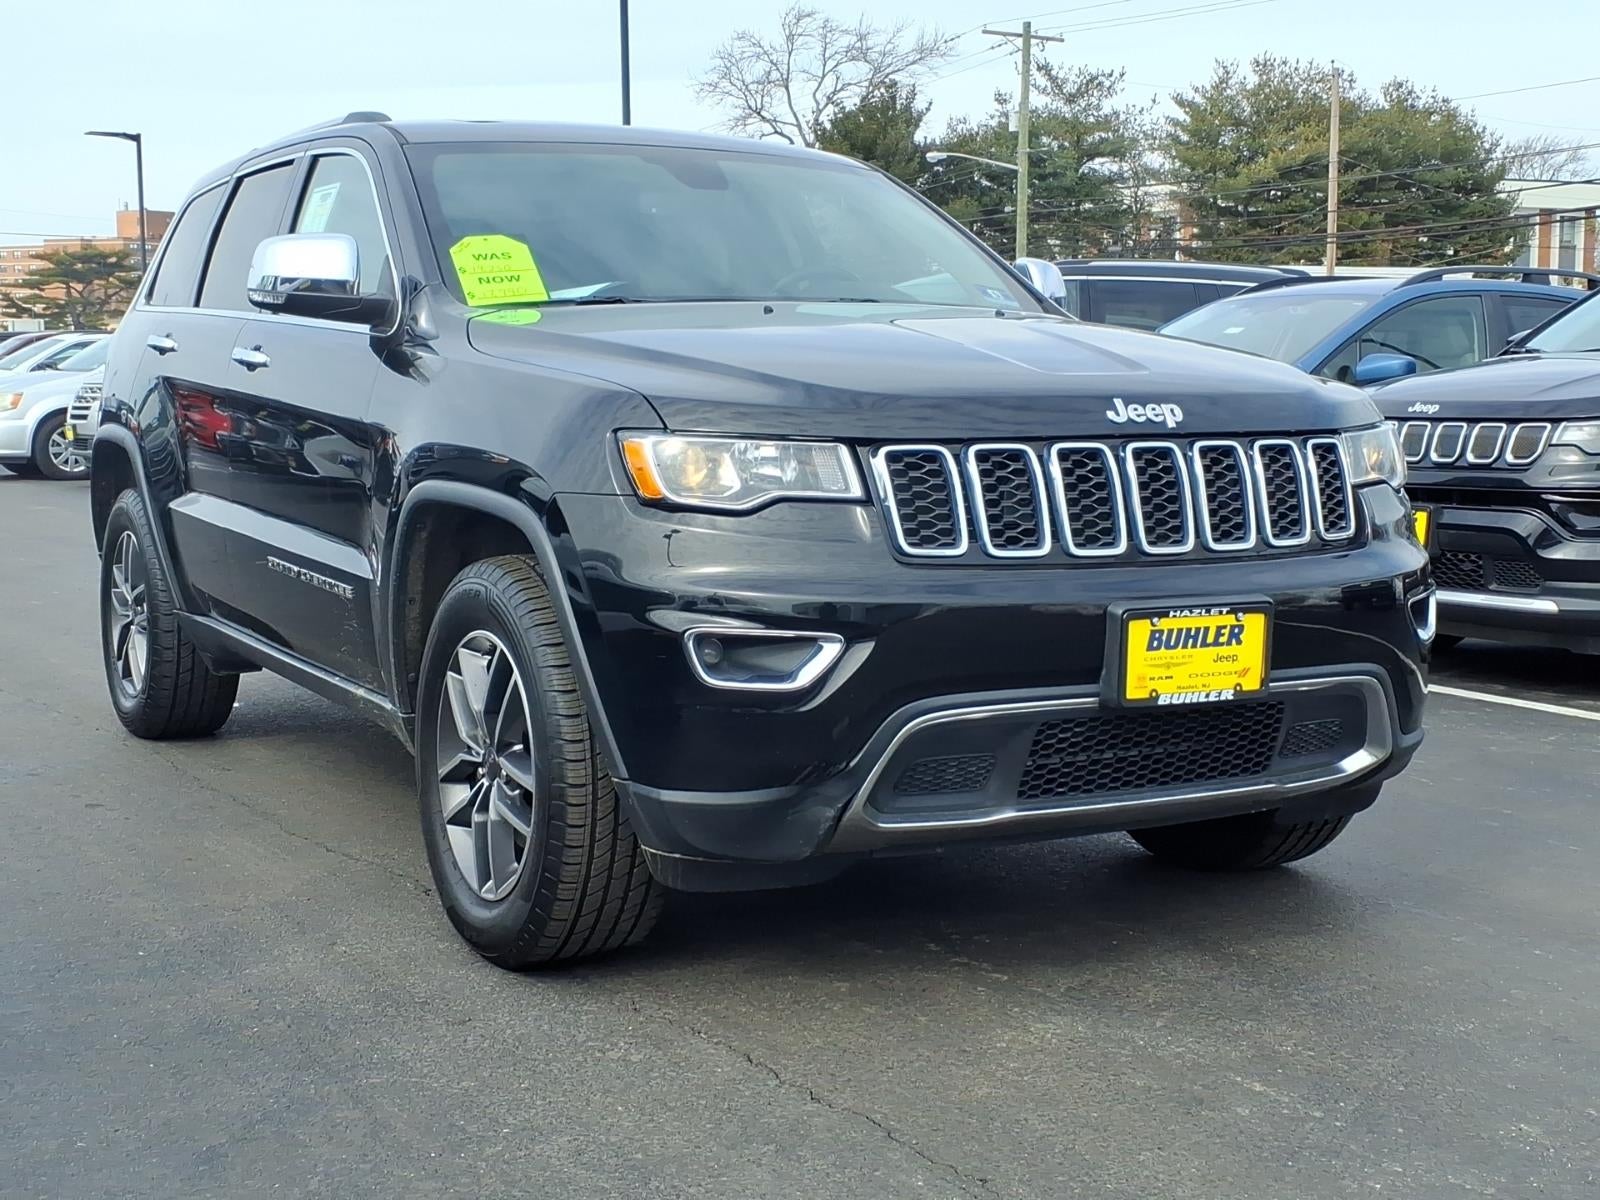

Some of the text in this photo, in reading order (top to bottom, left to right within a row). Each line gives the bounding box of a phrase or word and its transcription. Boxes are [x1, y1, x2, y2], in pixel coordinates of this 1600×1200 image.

[472, 252, 512, 261] WAS
[478, 274, 521, 285] NOW
[1105, 397, 1184, 429] Jeep
[1407, 402, 1440, 414] Jeep
[1169, 608, 1230, 618] HAZLET
[1146, 624, 1245, 652] BUHLER
[1213, 652, 1239, 664] Jeep
[1157, 689, 1235, 706] BUHLER
